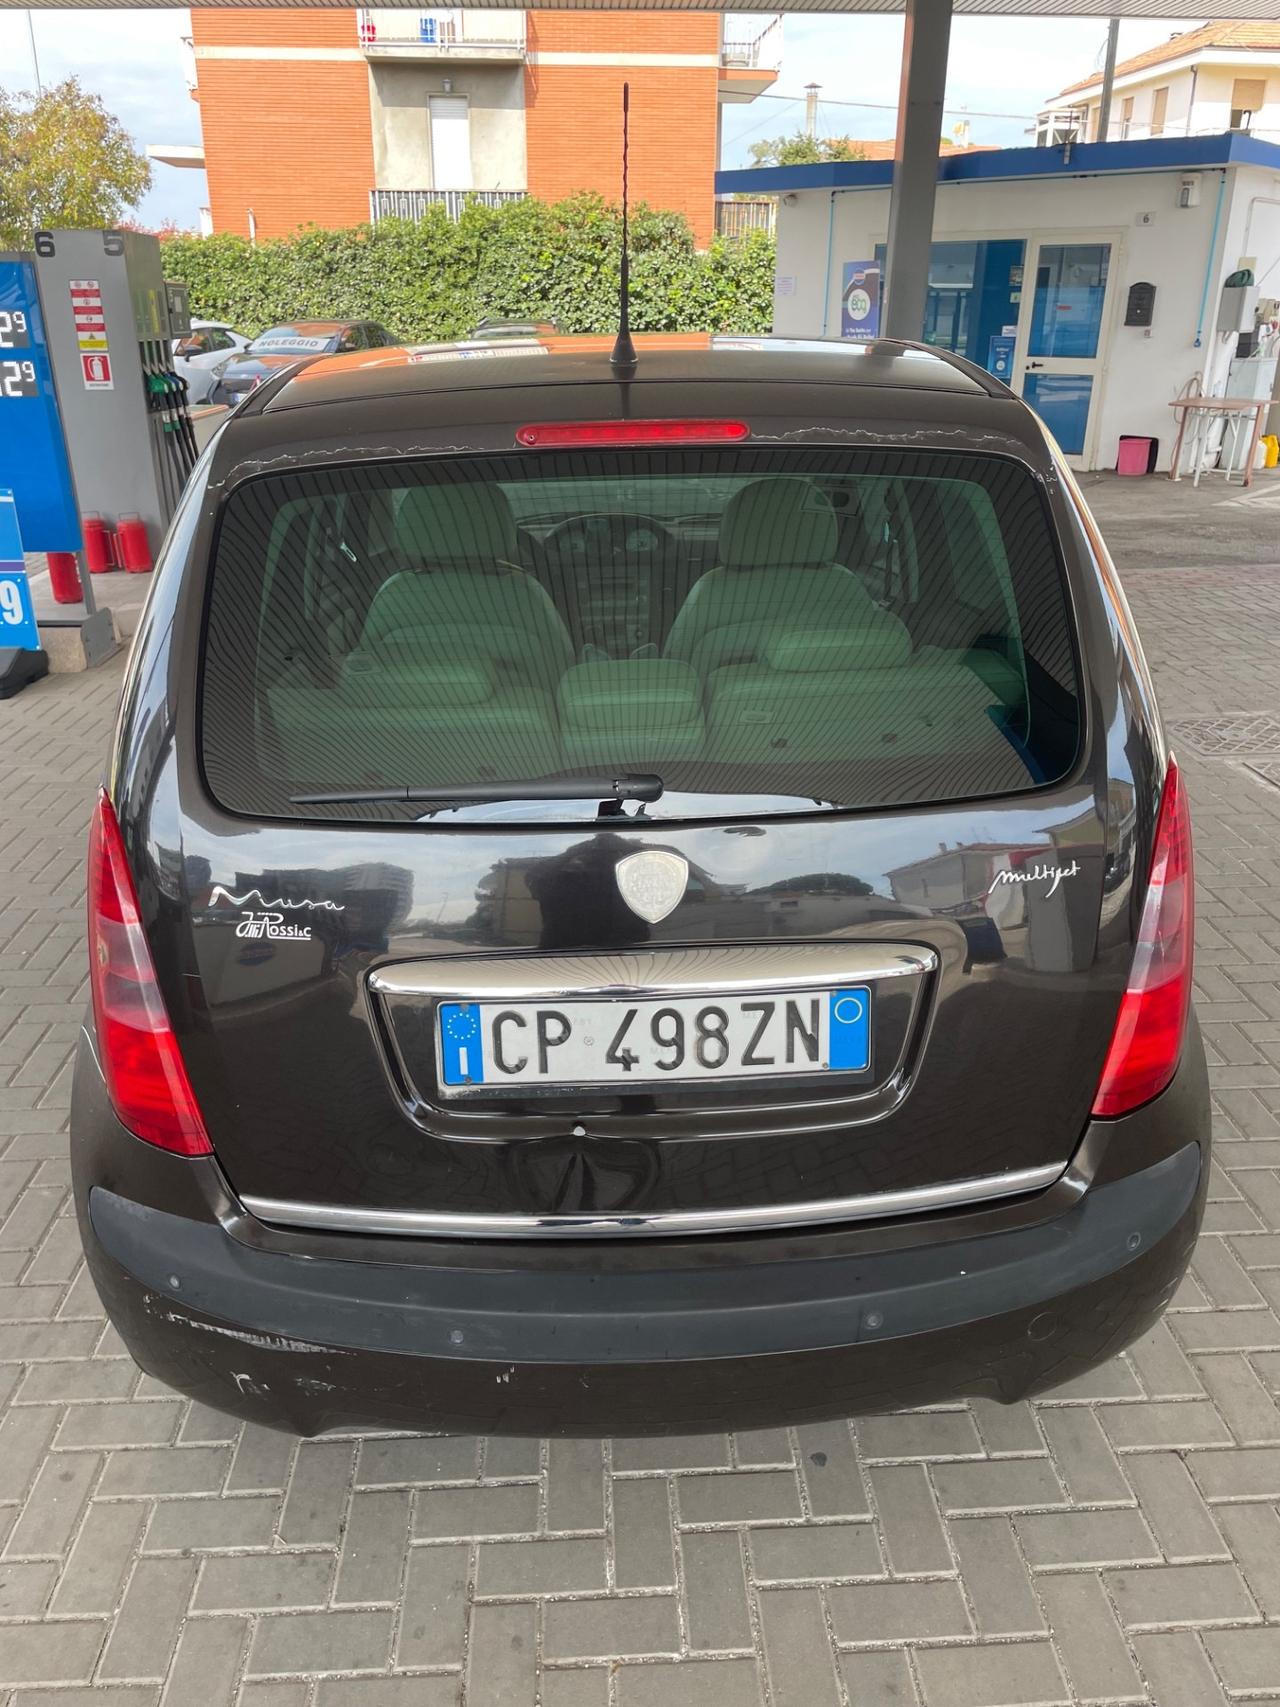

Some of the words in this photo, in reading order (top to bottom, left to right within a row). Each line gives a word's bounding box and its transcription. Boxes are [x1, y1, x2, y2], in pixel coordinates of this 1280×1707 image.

[1143, 214, 1150, 224] 6
[34, 231, 56, 257] 6
[103, 231, 125, 256] 5
[259, 339, 319, 347] NOLEGGIO
[208, 886, 345, 910] Musa
[491, 1010, 572, 1074] CP
[605, 998, 821, 1072] 498ZN
